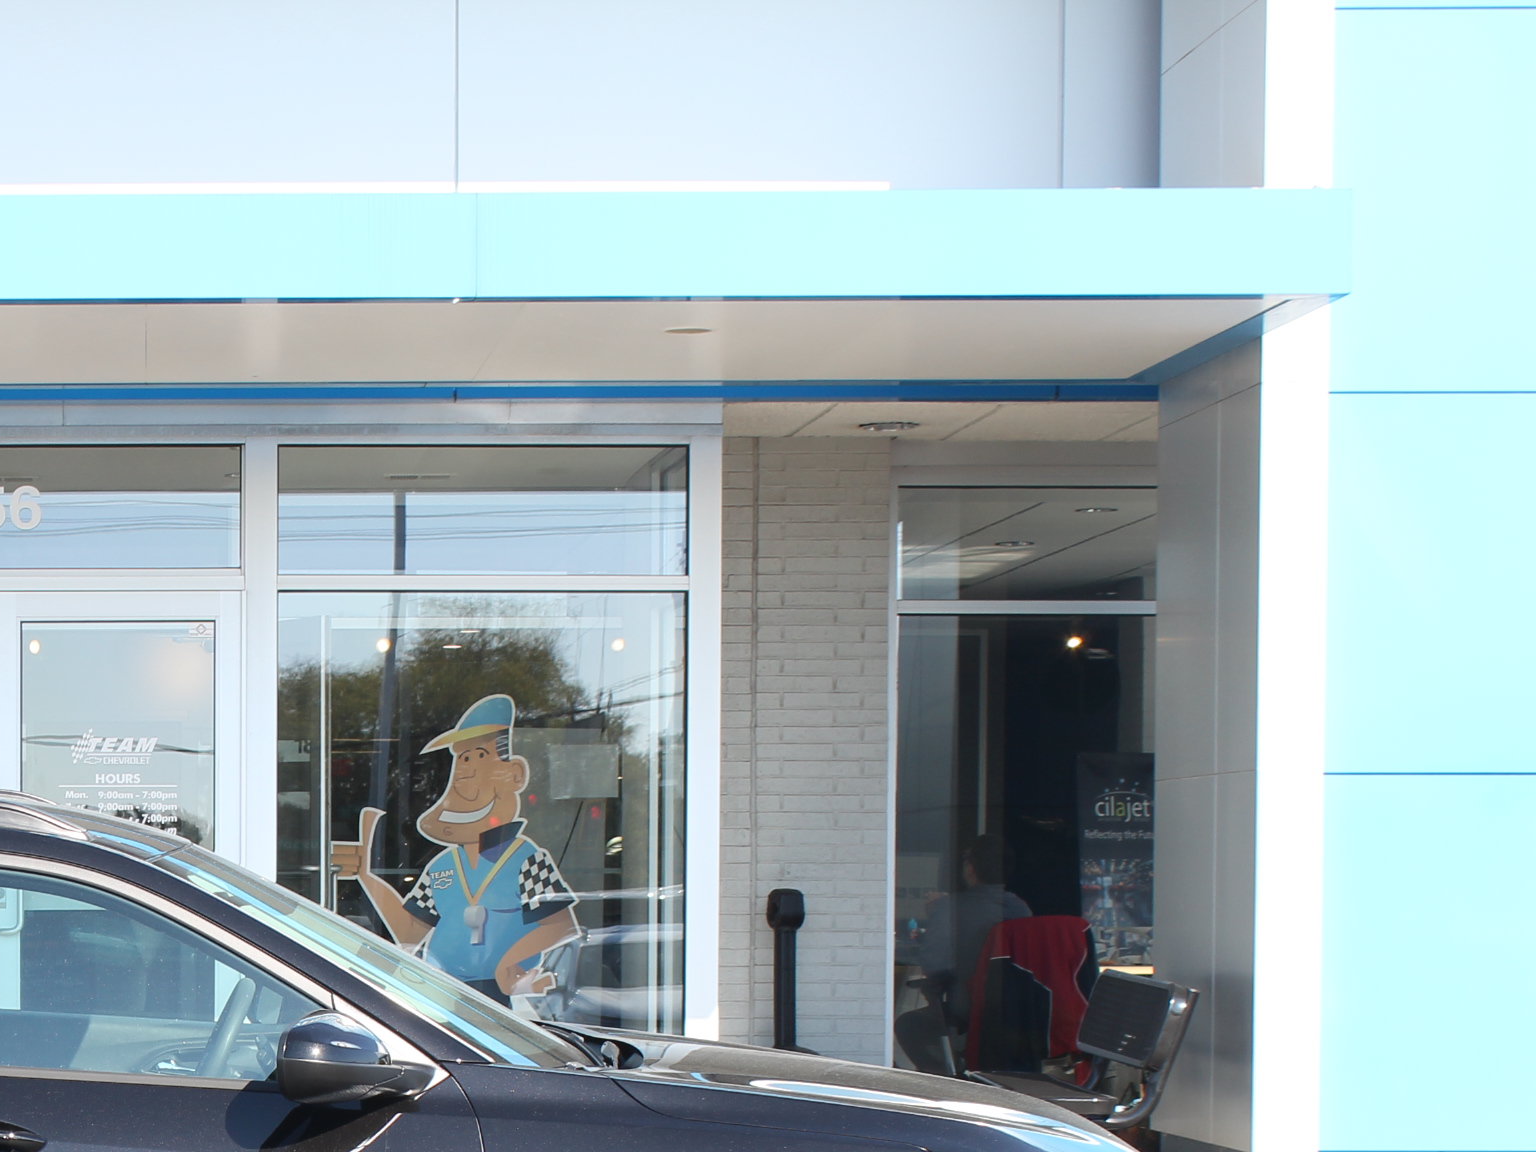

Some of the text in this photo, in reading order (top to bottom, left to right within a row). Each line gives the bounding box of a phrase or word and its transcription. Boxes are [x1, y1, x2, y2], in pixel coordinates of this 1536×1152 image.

[86, 737, 158, 753] TEAM
[103, 756, 151, 765] CHEVROLET
[95, 773, 141, 784] HOURS
[65, 790, 89, 799] Mon.
[97, 790, 134, 799] 9:00am
[142, 790, 178, 801] 7:00pm
[97, 802, 134, 813] 9:00am
[142, 802, 178, 813] 7:00pm
[1095, 796, 1151, 822] cilajet
[141, 813, 178, 825] 7:00pm
[430, 869, 454, 879] TEAM
